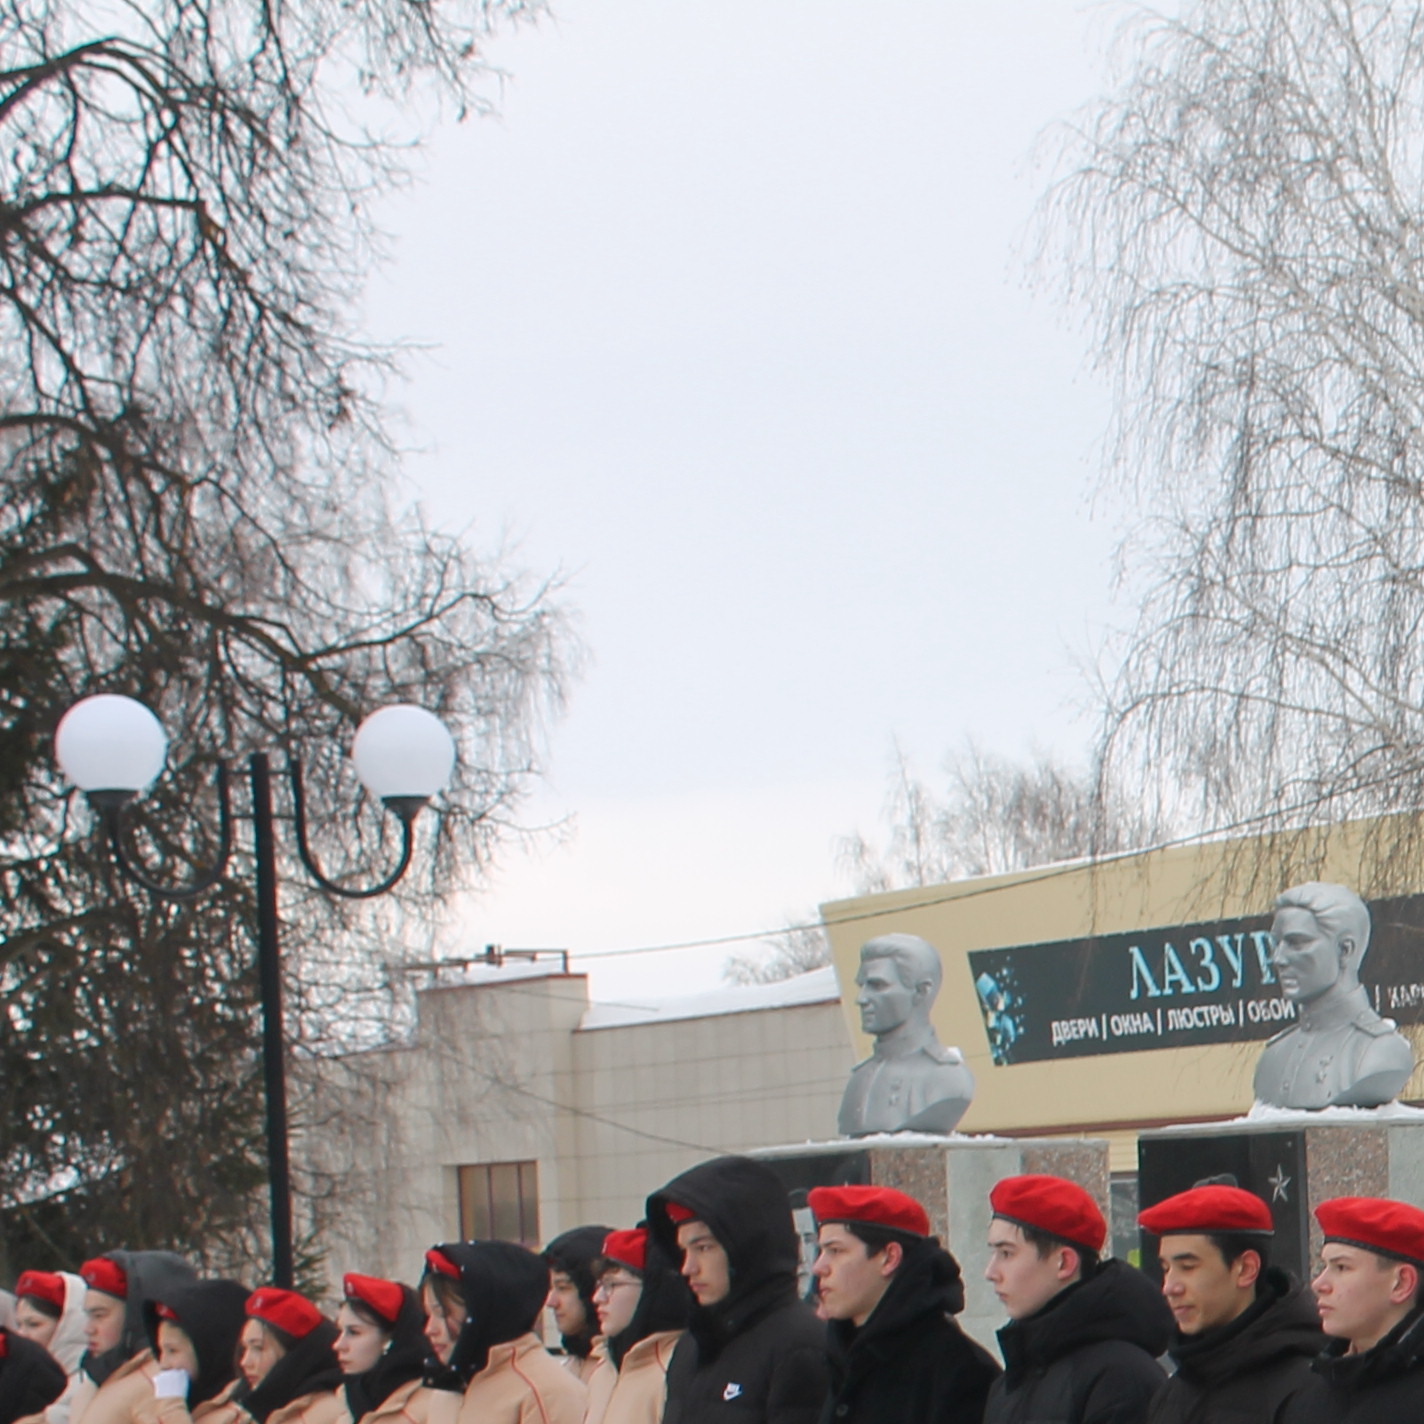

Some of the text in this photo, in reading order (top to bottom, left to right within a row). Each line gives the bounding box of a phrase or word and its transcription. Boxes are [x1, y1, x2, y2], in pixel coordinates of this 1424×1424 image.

[1051, 1016, 1099, 1046] ДВЕРИ
[1110, 1009, 1154, 1036] ОКНА
[1168, 1003, 1235, 1030] ЛЮСТРЫ
[1247, 998, 1295, 1023] ОБОИ
